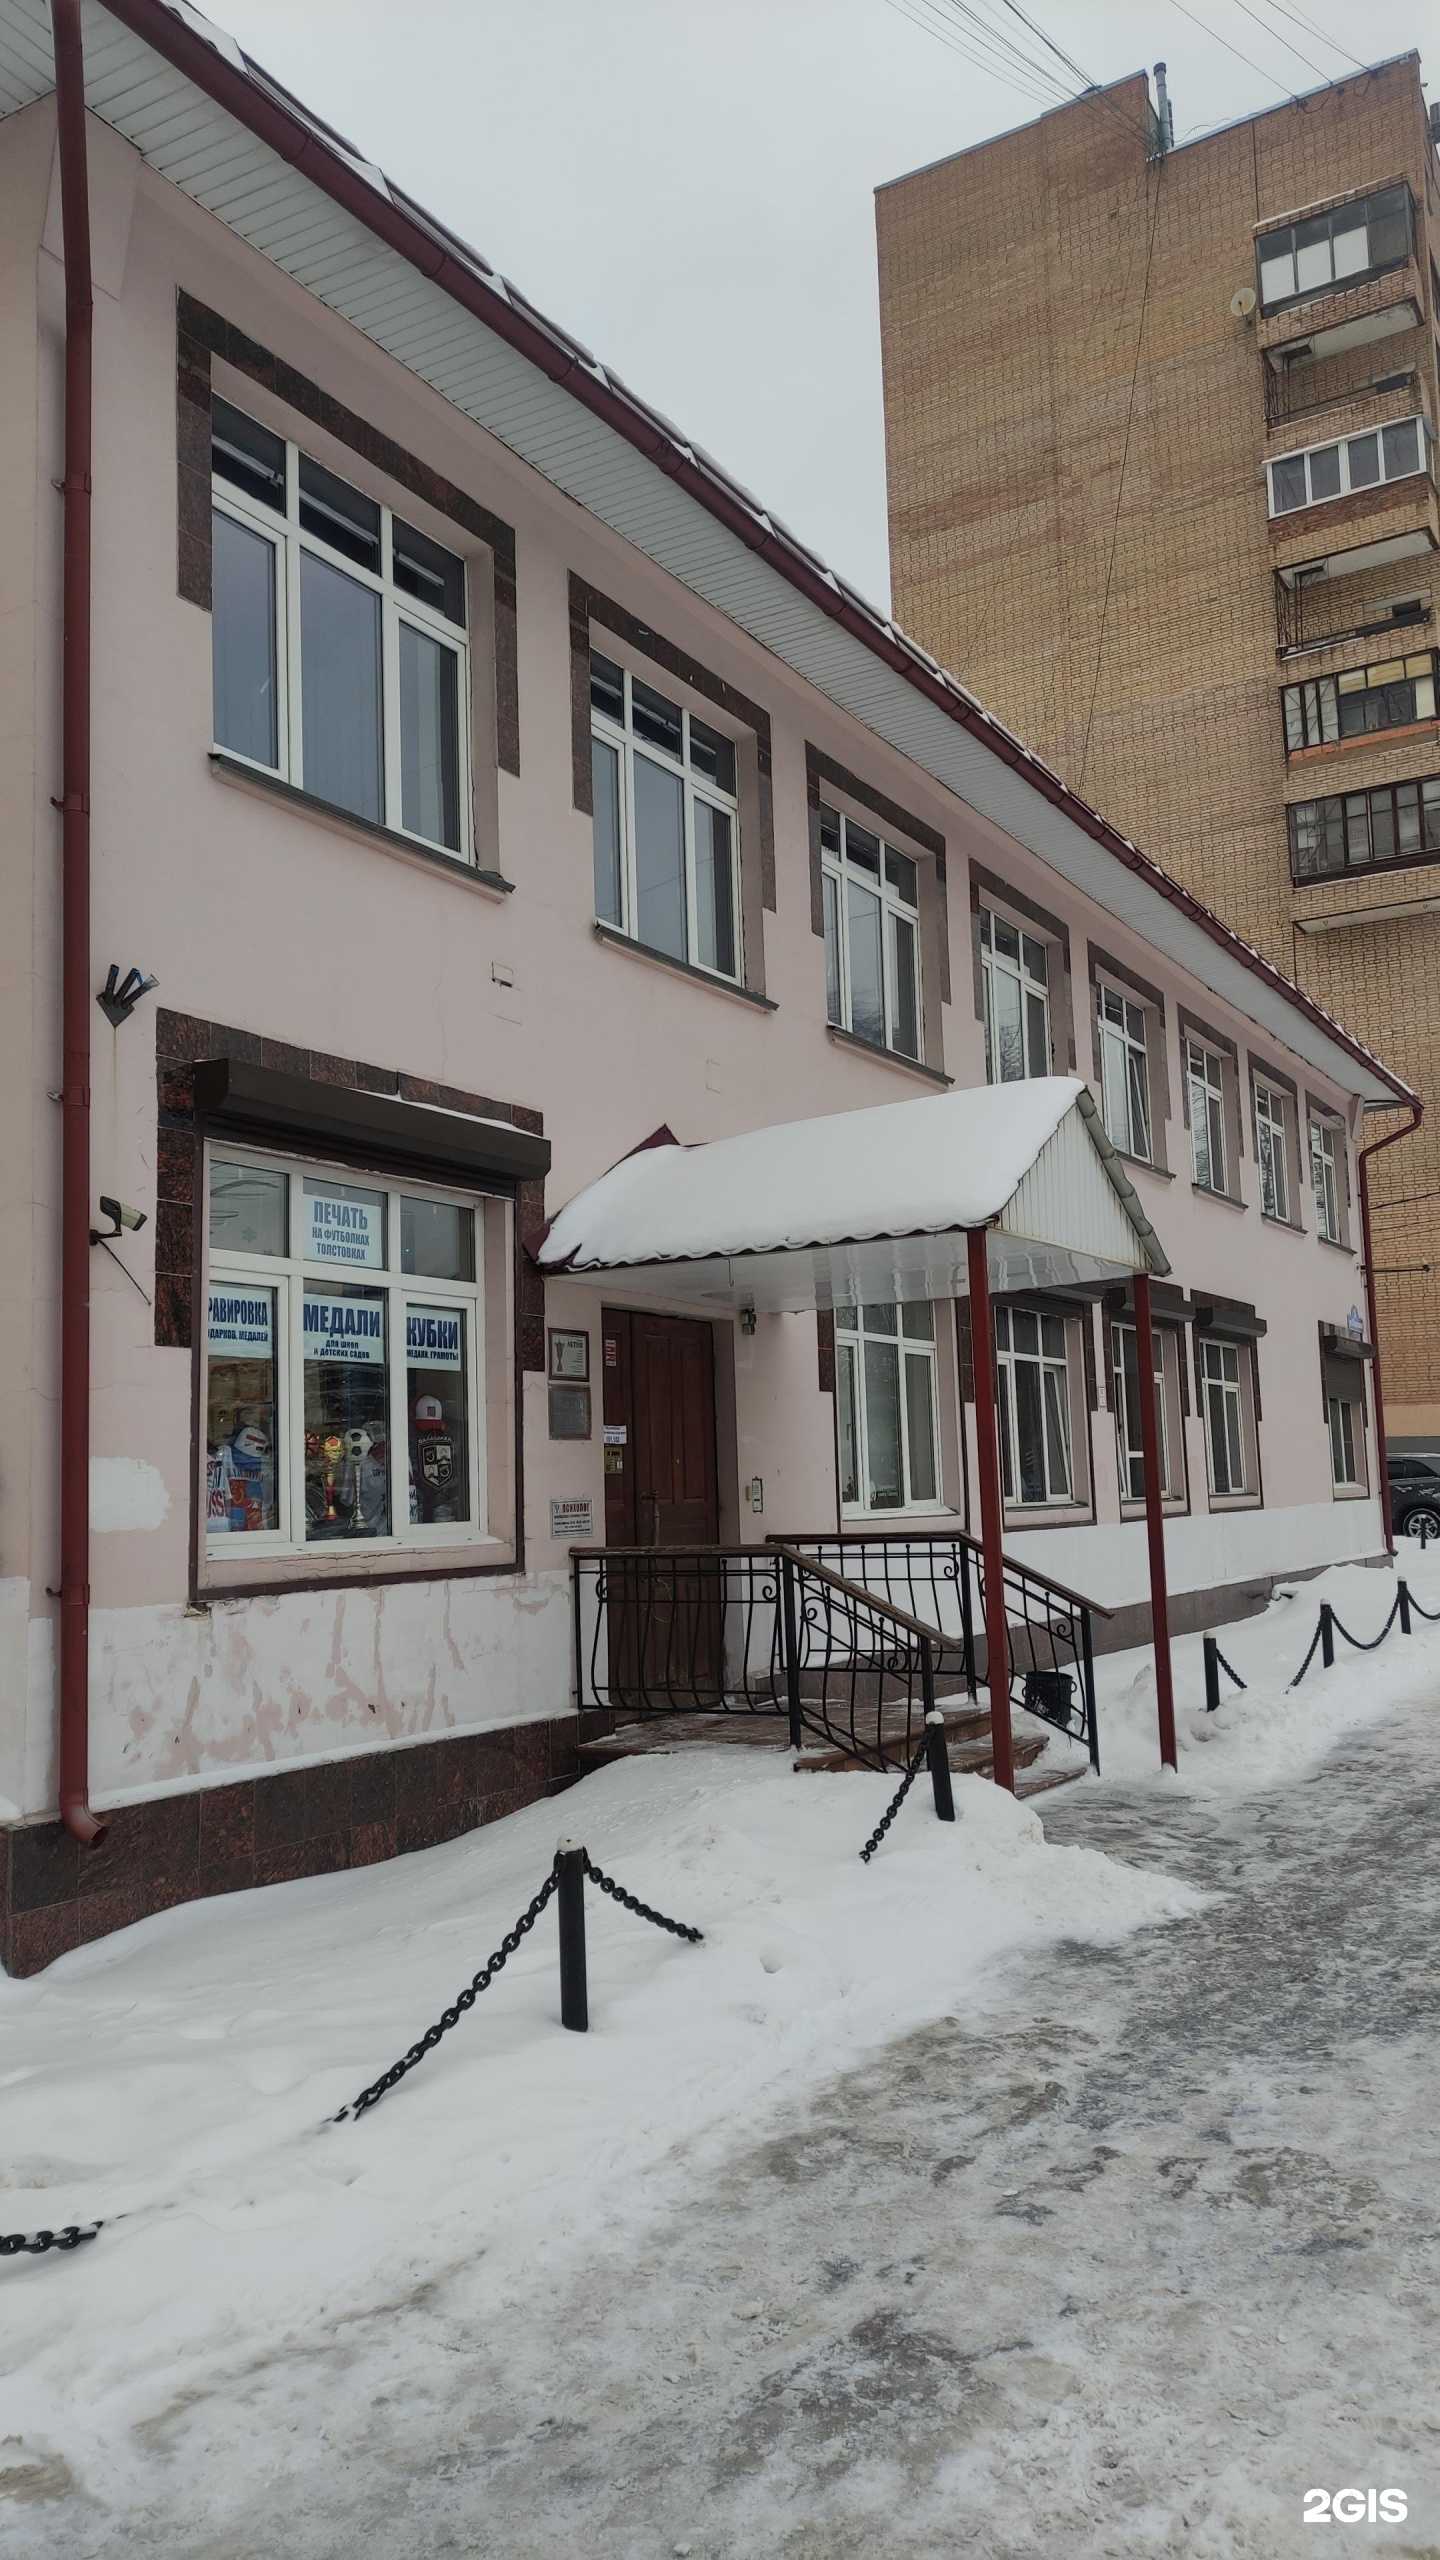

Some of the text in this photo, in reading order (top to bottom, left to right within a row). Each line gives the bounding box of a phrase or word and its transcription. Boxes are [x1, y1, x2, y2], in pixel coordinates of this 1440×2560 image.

[313, 1200, 368, 1230] ПЕЧАТЬ
[312, 1226, 323, 1239] НА
[316, 1242, 366, 1260] ТОЛСТОВКАХ
[303, 1303, 380, 1339] МЕДАЛИ
[407, 1316, 458, 1350] КУБКИ
